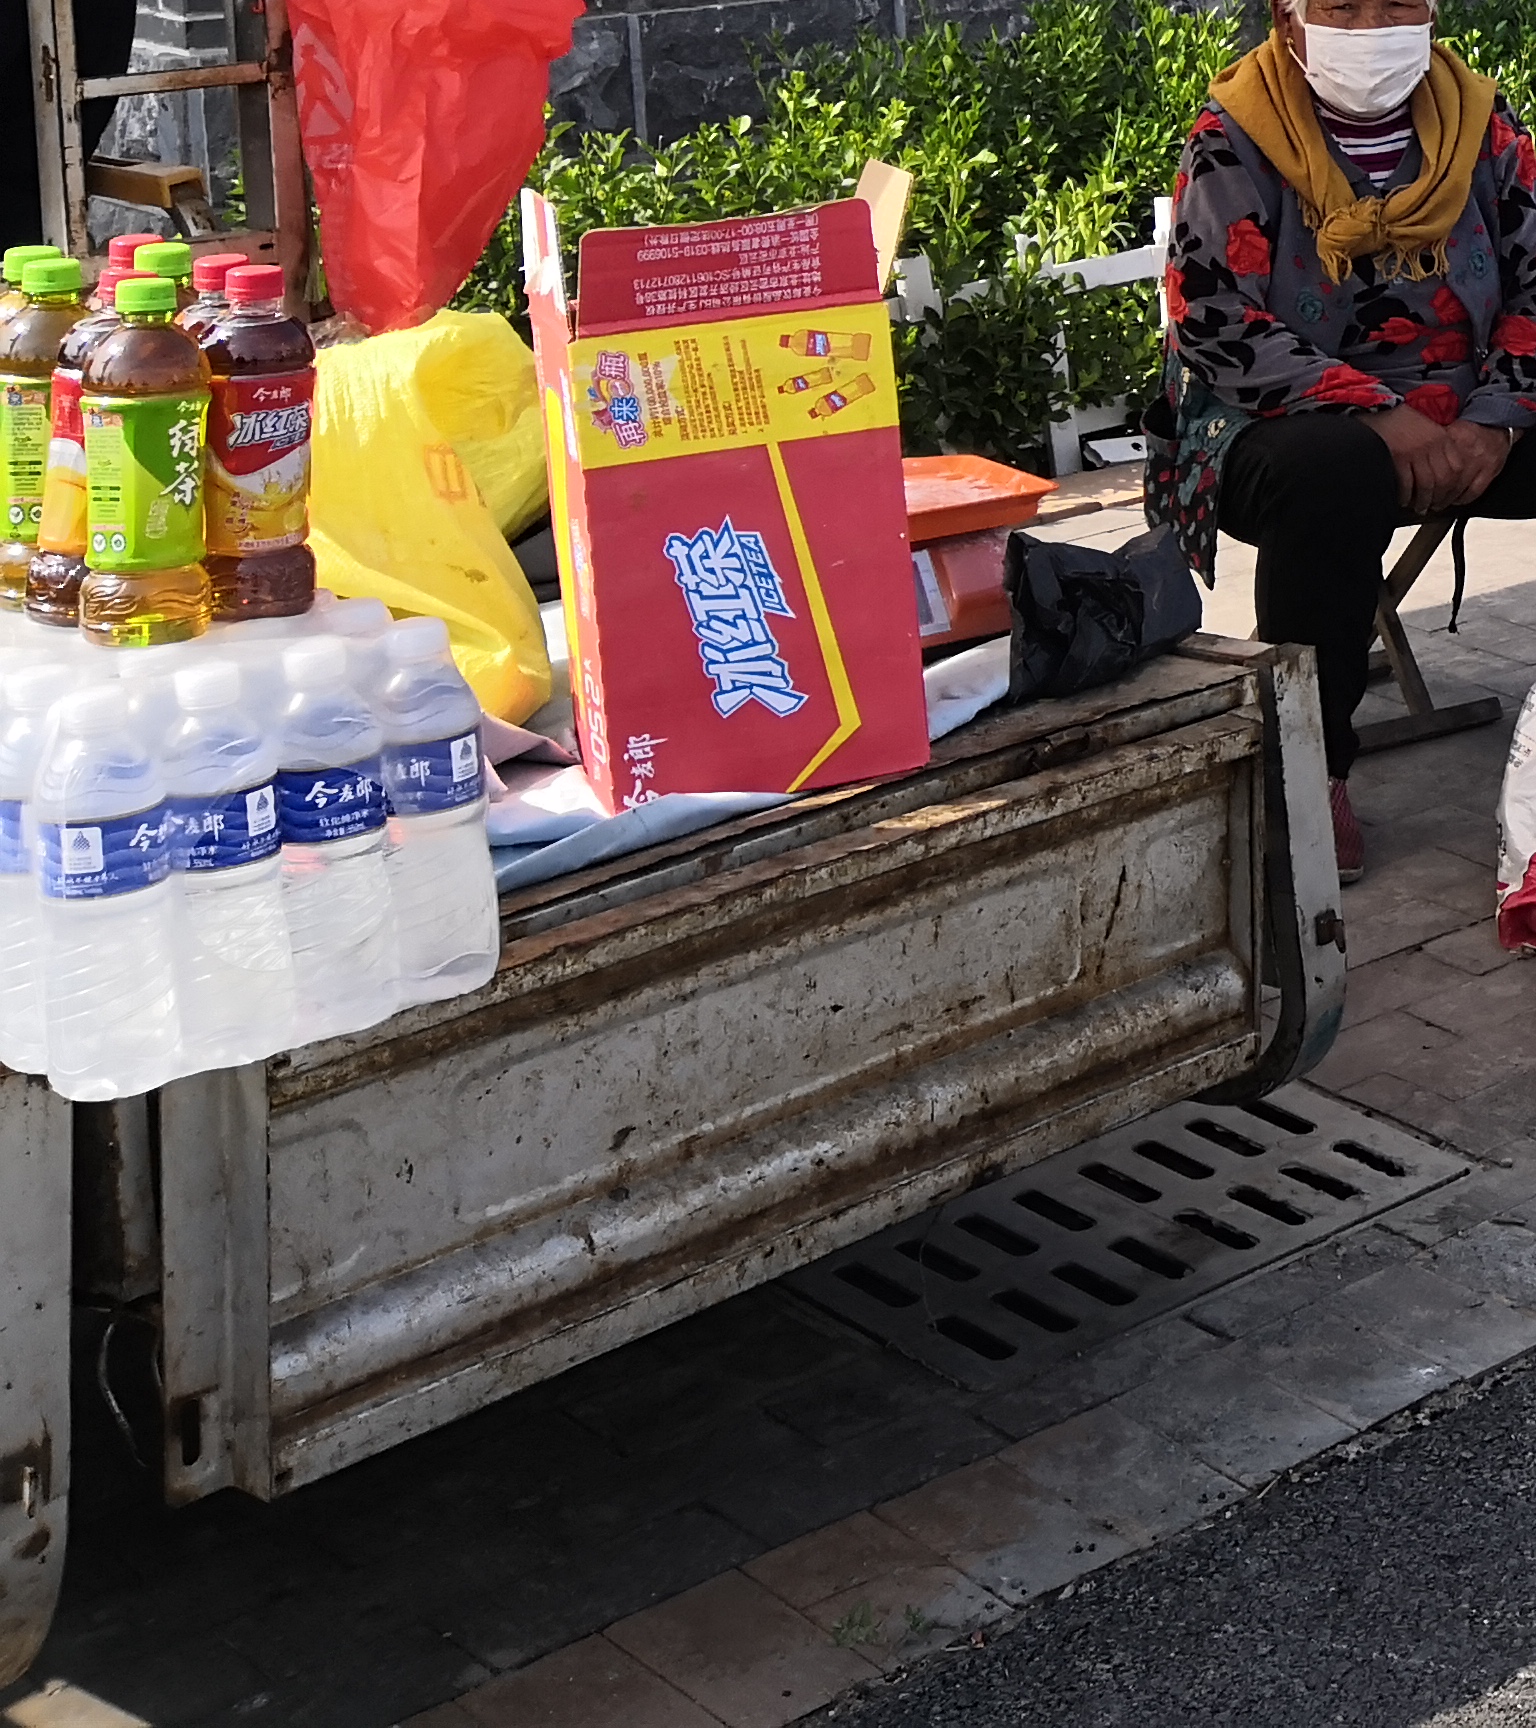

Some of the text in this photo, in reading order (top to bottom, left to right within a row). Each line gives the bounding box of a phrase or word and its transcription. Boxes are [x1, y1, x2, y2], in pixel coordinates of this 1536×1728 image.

[663, 514, 809, 718] 冰红茶
[305, 776, 373, 809] 今麦郎
